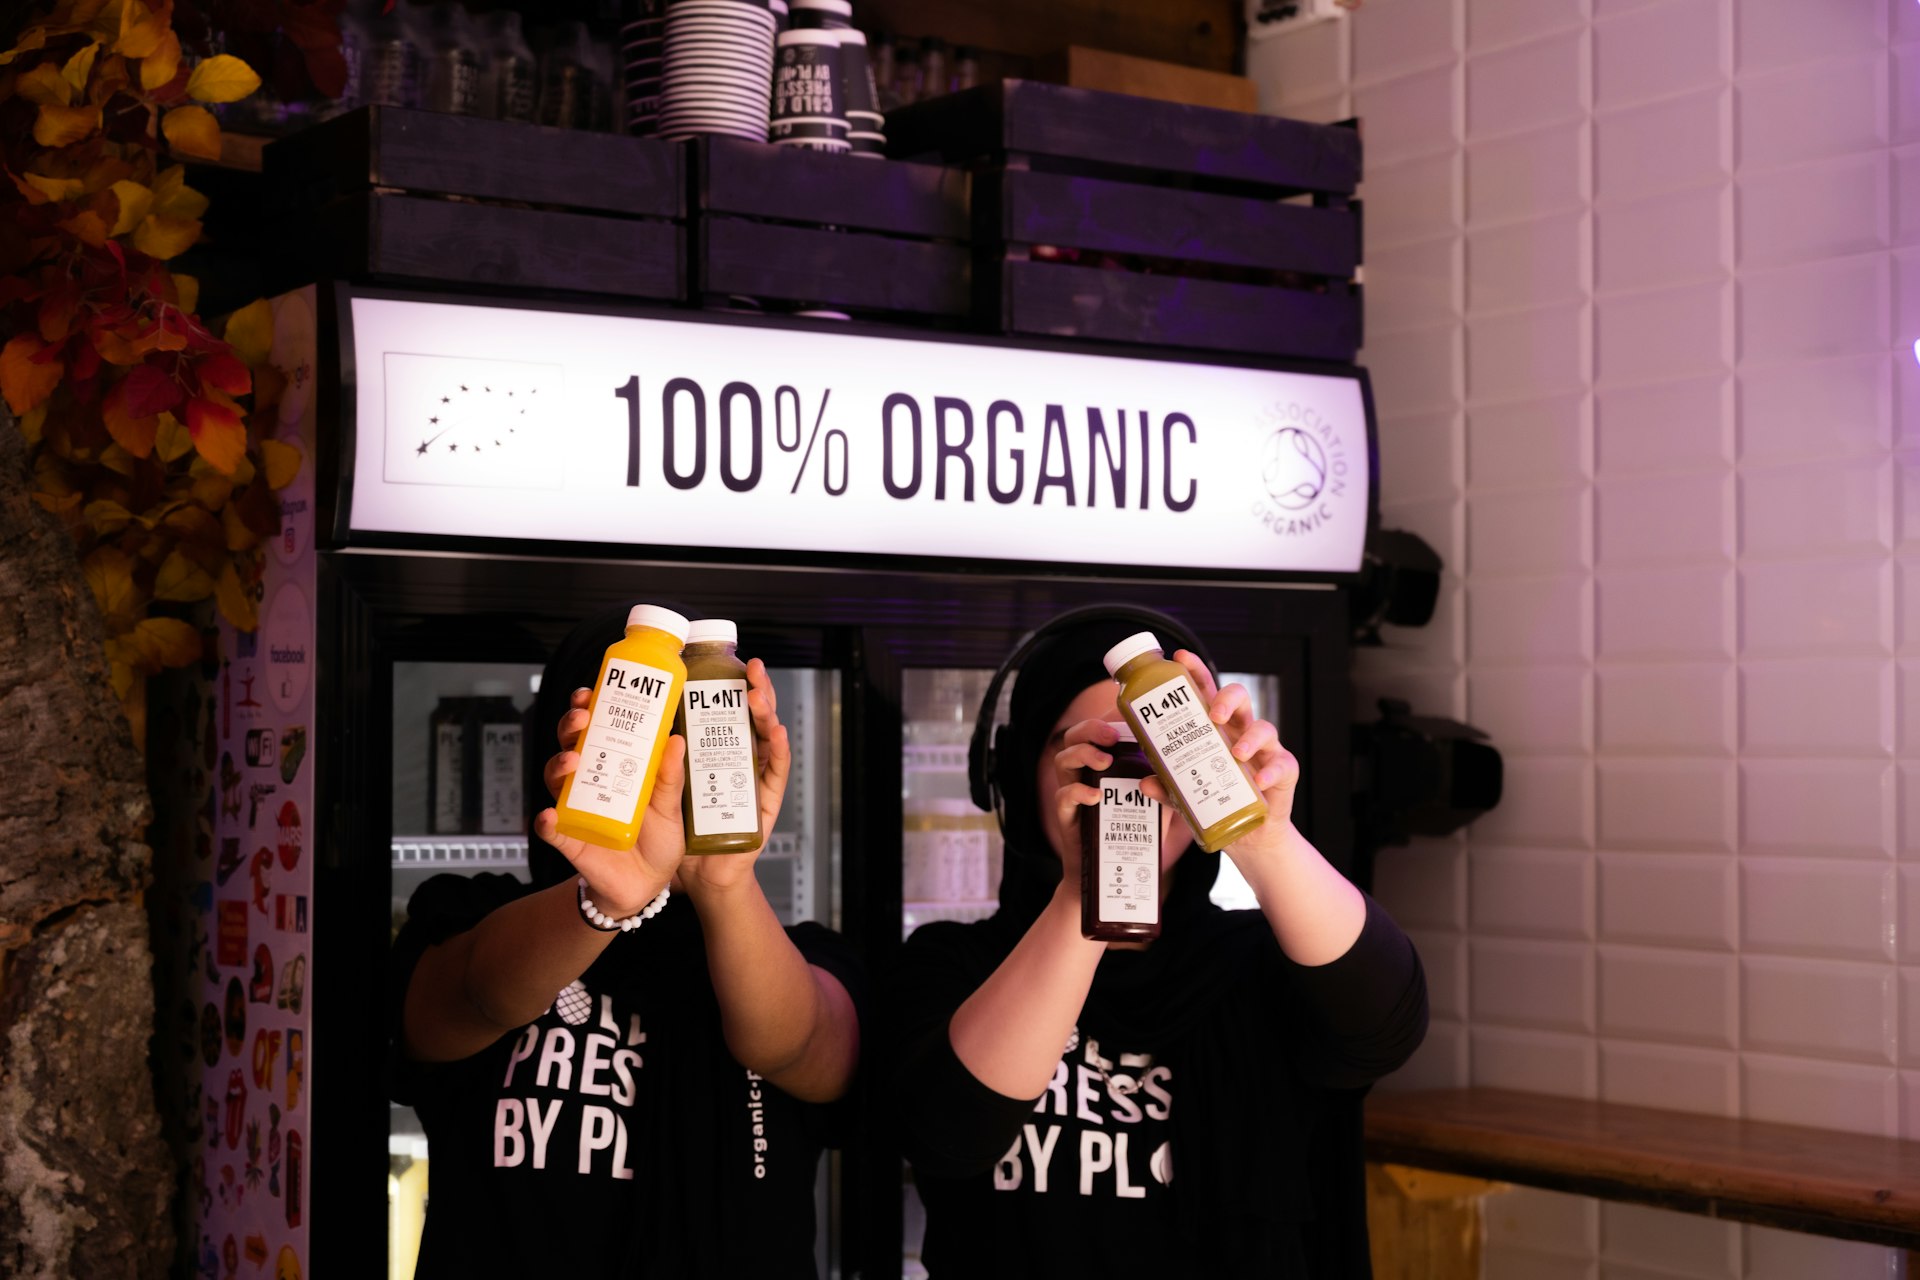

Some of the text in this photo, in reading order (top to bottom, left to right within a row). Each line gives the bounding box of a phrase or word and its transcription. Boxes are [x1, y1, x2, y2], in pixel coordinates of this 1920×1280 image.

[614, 375, 1198, 513] 100% ORGANIC
[270, 643, 305, 664] facebook
[608, 705, 646, 723] ORANGE
[610, 718, 637, 732] JUICE
[705, 726, 733, 736] GREEN
[1166, 719, 1198, 741] ALKALINE
[700, 737, 740, 747] GODDESS
[1161, 723, 1213, 756] GREEN GODDESS
[1110, 822, 1147, 832] CRIMSON
[1104, 832, 1153, 843] AWAKENING
[1033, 1058, 1173, 1125] RESS
[494, 1097, 564, 1169] BY
